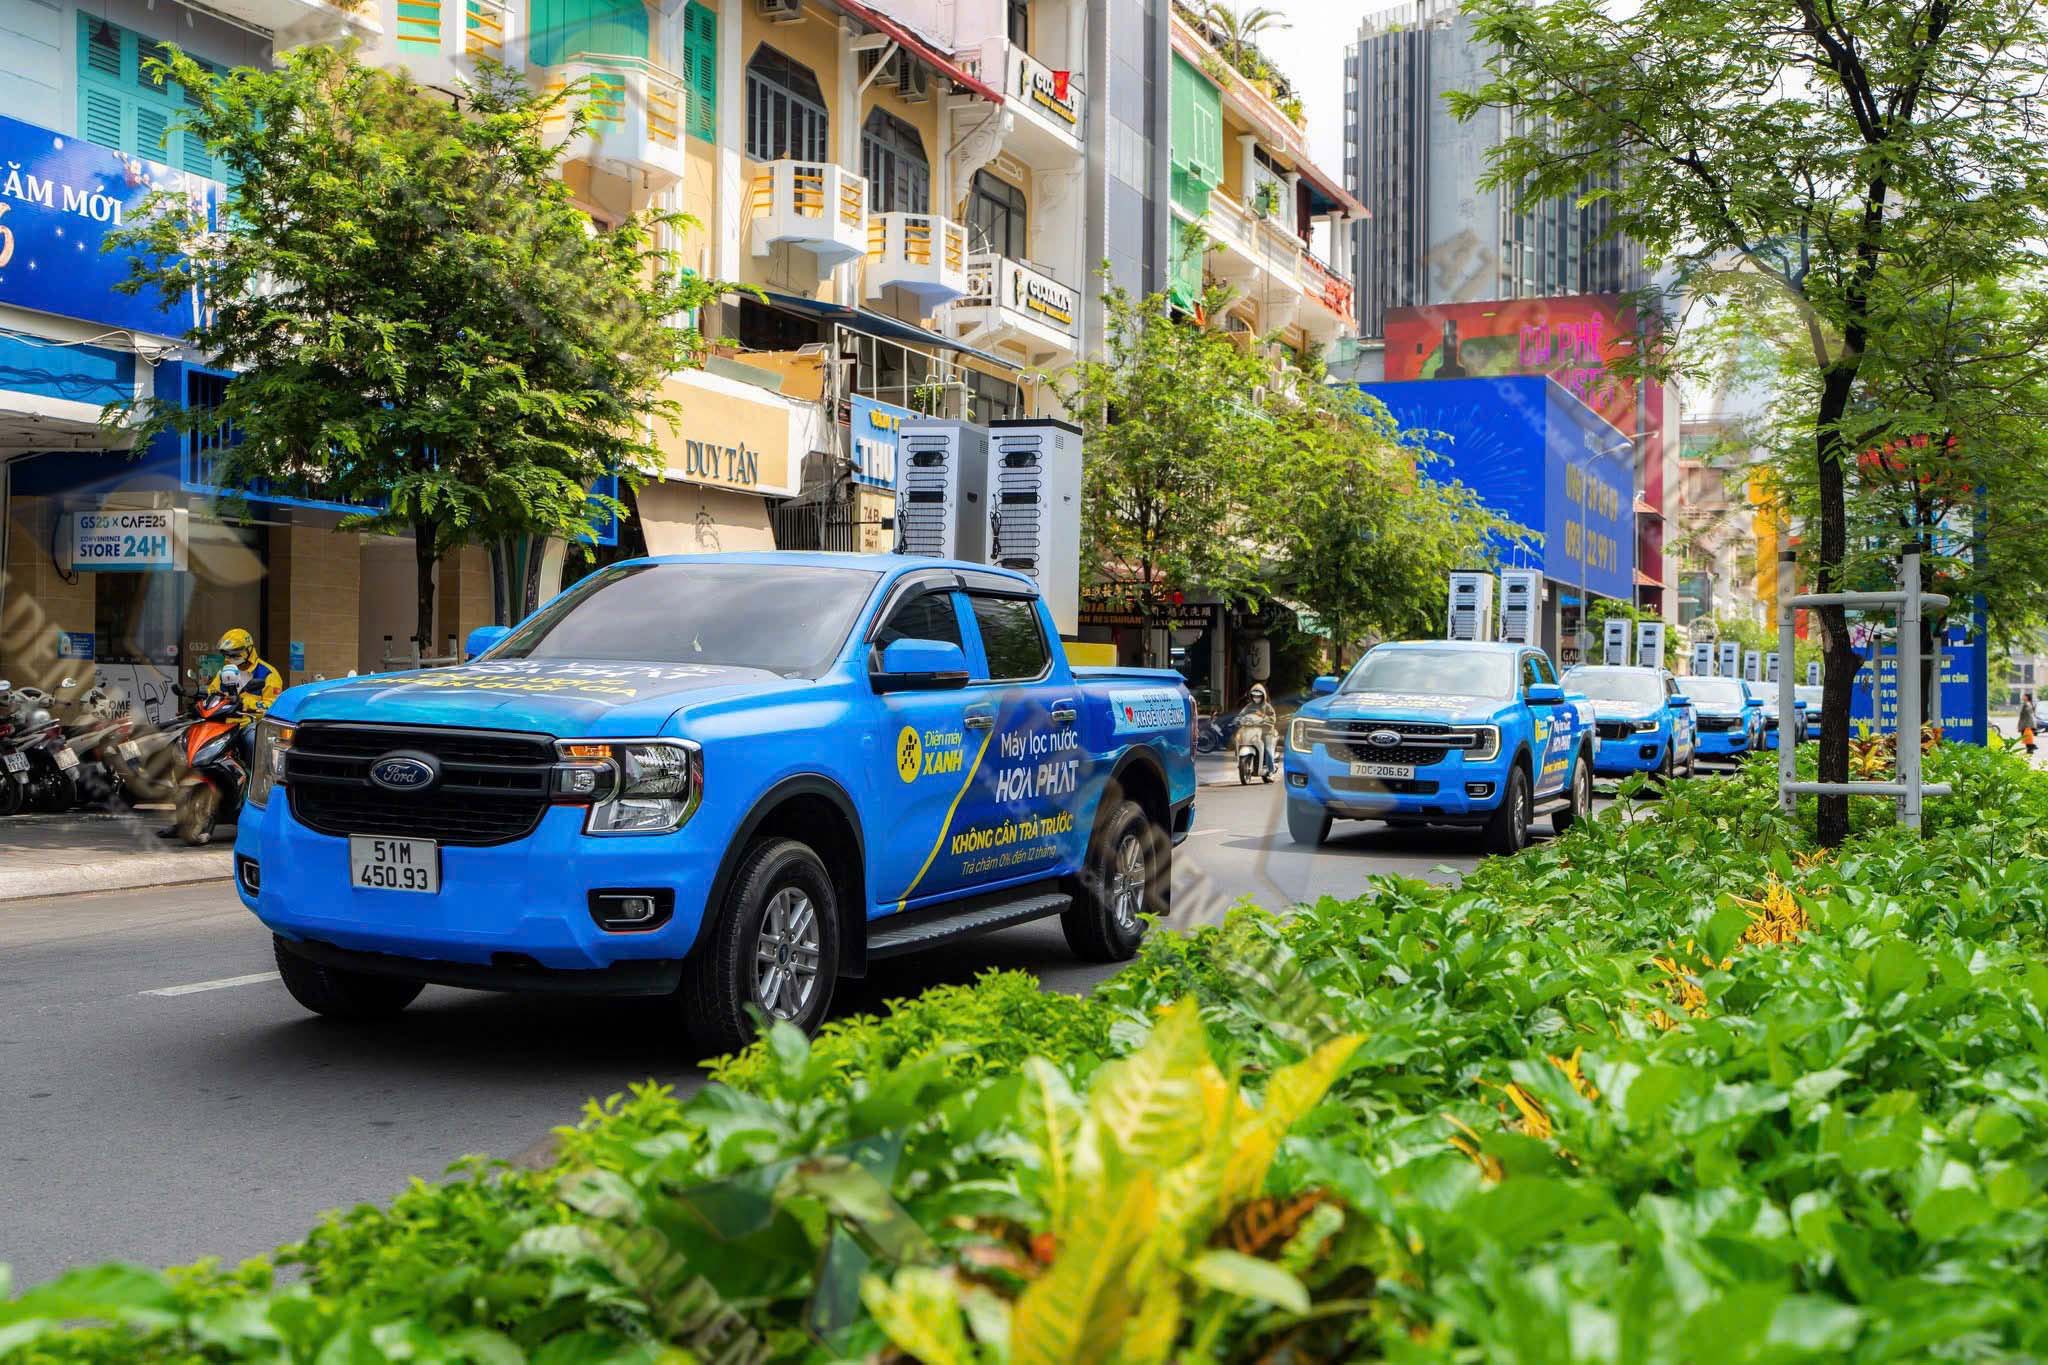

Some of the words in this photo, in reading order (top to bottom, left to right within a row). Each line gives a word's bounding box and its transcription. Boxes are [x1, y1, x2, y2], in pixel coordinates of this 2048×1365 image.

[0, 160, 55, 208] ĂM
[61, 184, 123, 226] MỚI
[685, 439, 723, 479] DUY
[724, 441, 759, 486] TÂN
[80, 515, 110, 529] GS25
[121, 514, 167, 529] CAFE25
[79, 543, 121, 558] STORE
[123, 534, 168, 558] 24H
[924, 731, 944, 750] Điện
[945, 730, 963, 747] máy
[1001, 732, 1026, 761] Máy
[1028, 729, 1048, 761] lọc
[1050, 726, 1078, 752] nước
[922, 749, 964, 775] XANH
[1354, 764, 1409, 778] 70C-206.62
[951, 827, 993, 856] KHÔNG
[994, 819, 1018, 847] CẦN
[1019, 813, 1039, 841] TRẢ
[1040, 810, 1073, 837] TRƯỚC
[374, 840, 412, 864] 51M
[1011, 849, 1027, 864] đến
[1035, 844, 1058, 860] tháng
[360, 864, 429, 890] 450.93
